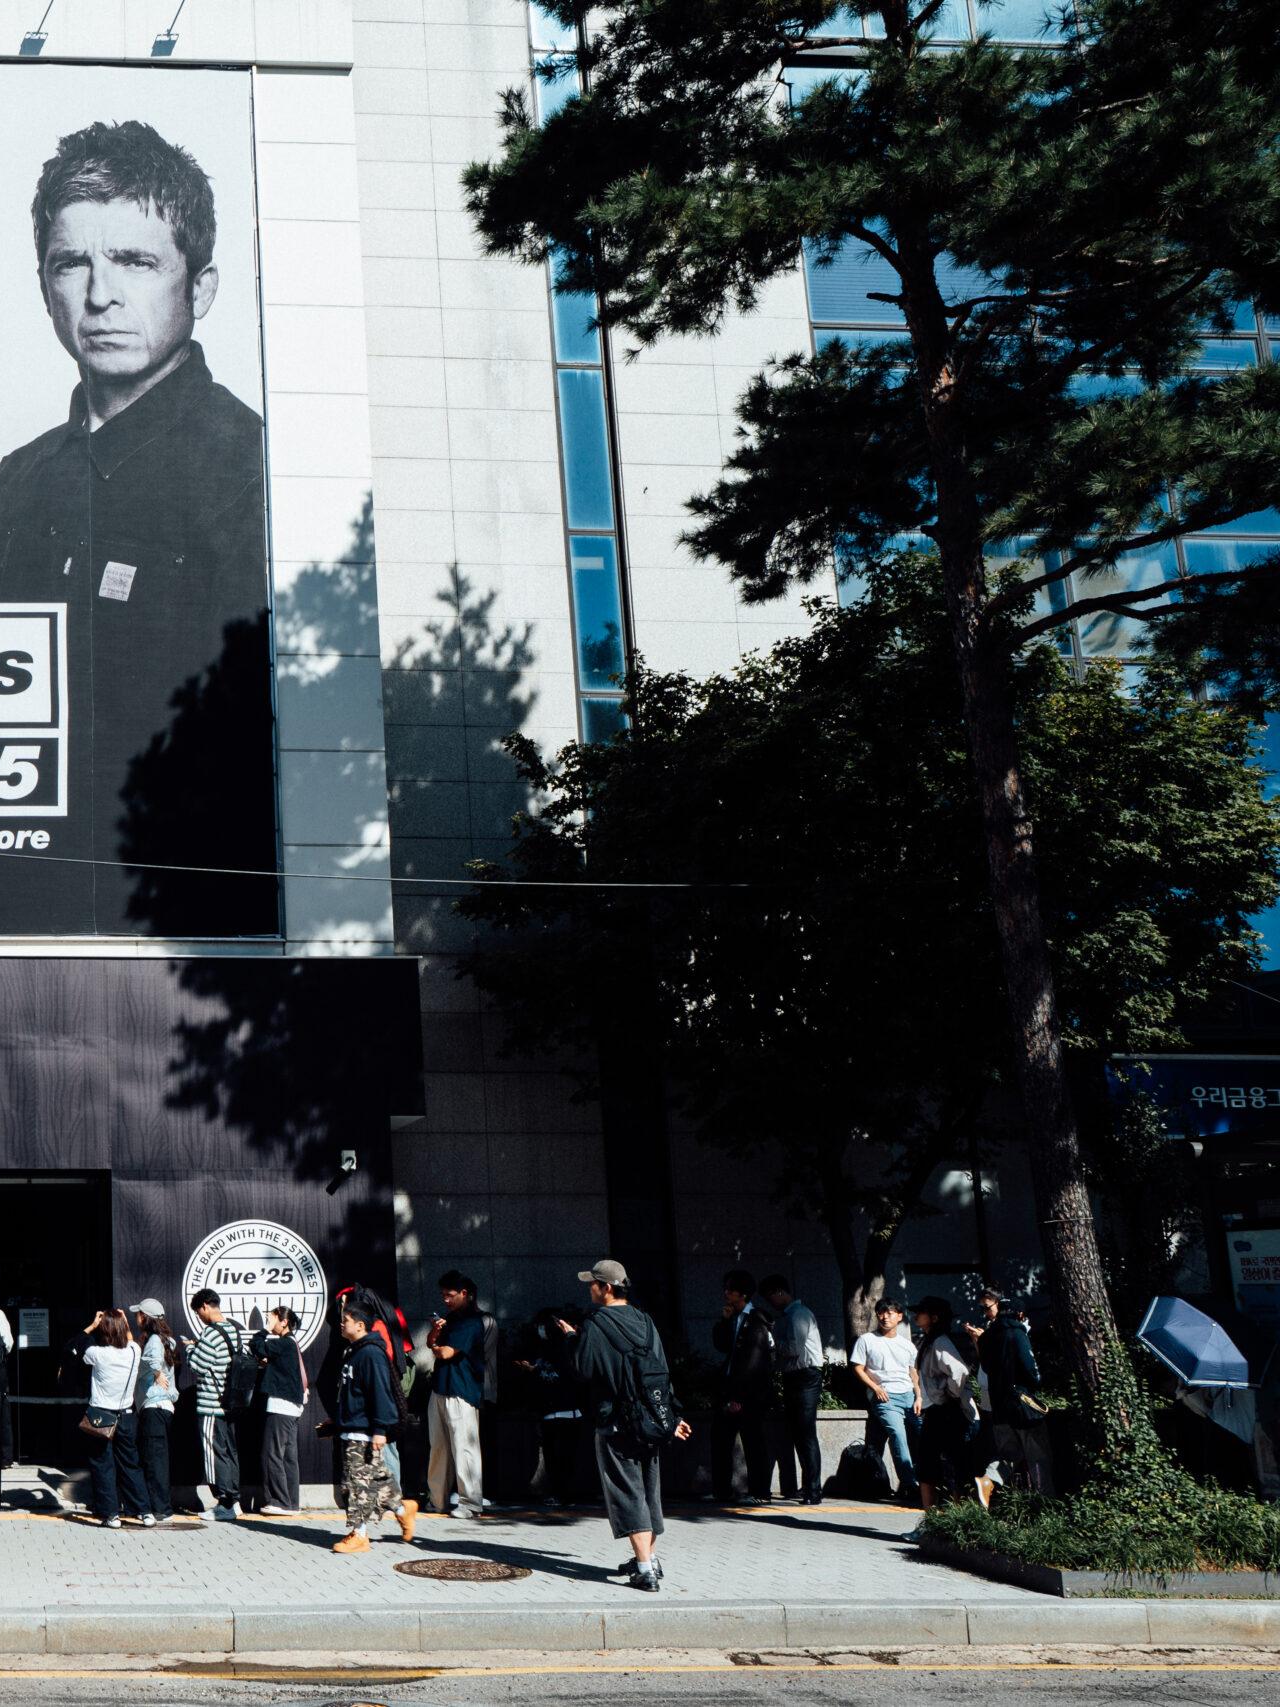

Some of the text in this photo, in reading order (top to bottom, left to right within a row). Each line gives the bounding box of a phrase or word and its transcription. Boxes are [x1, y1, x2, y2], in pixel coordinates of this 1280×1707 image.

[192, 1229, 318, 1288] THE BAND WITH THE 3 STRIPES
[216, 1268, 256, 1284] live
